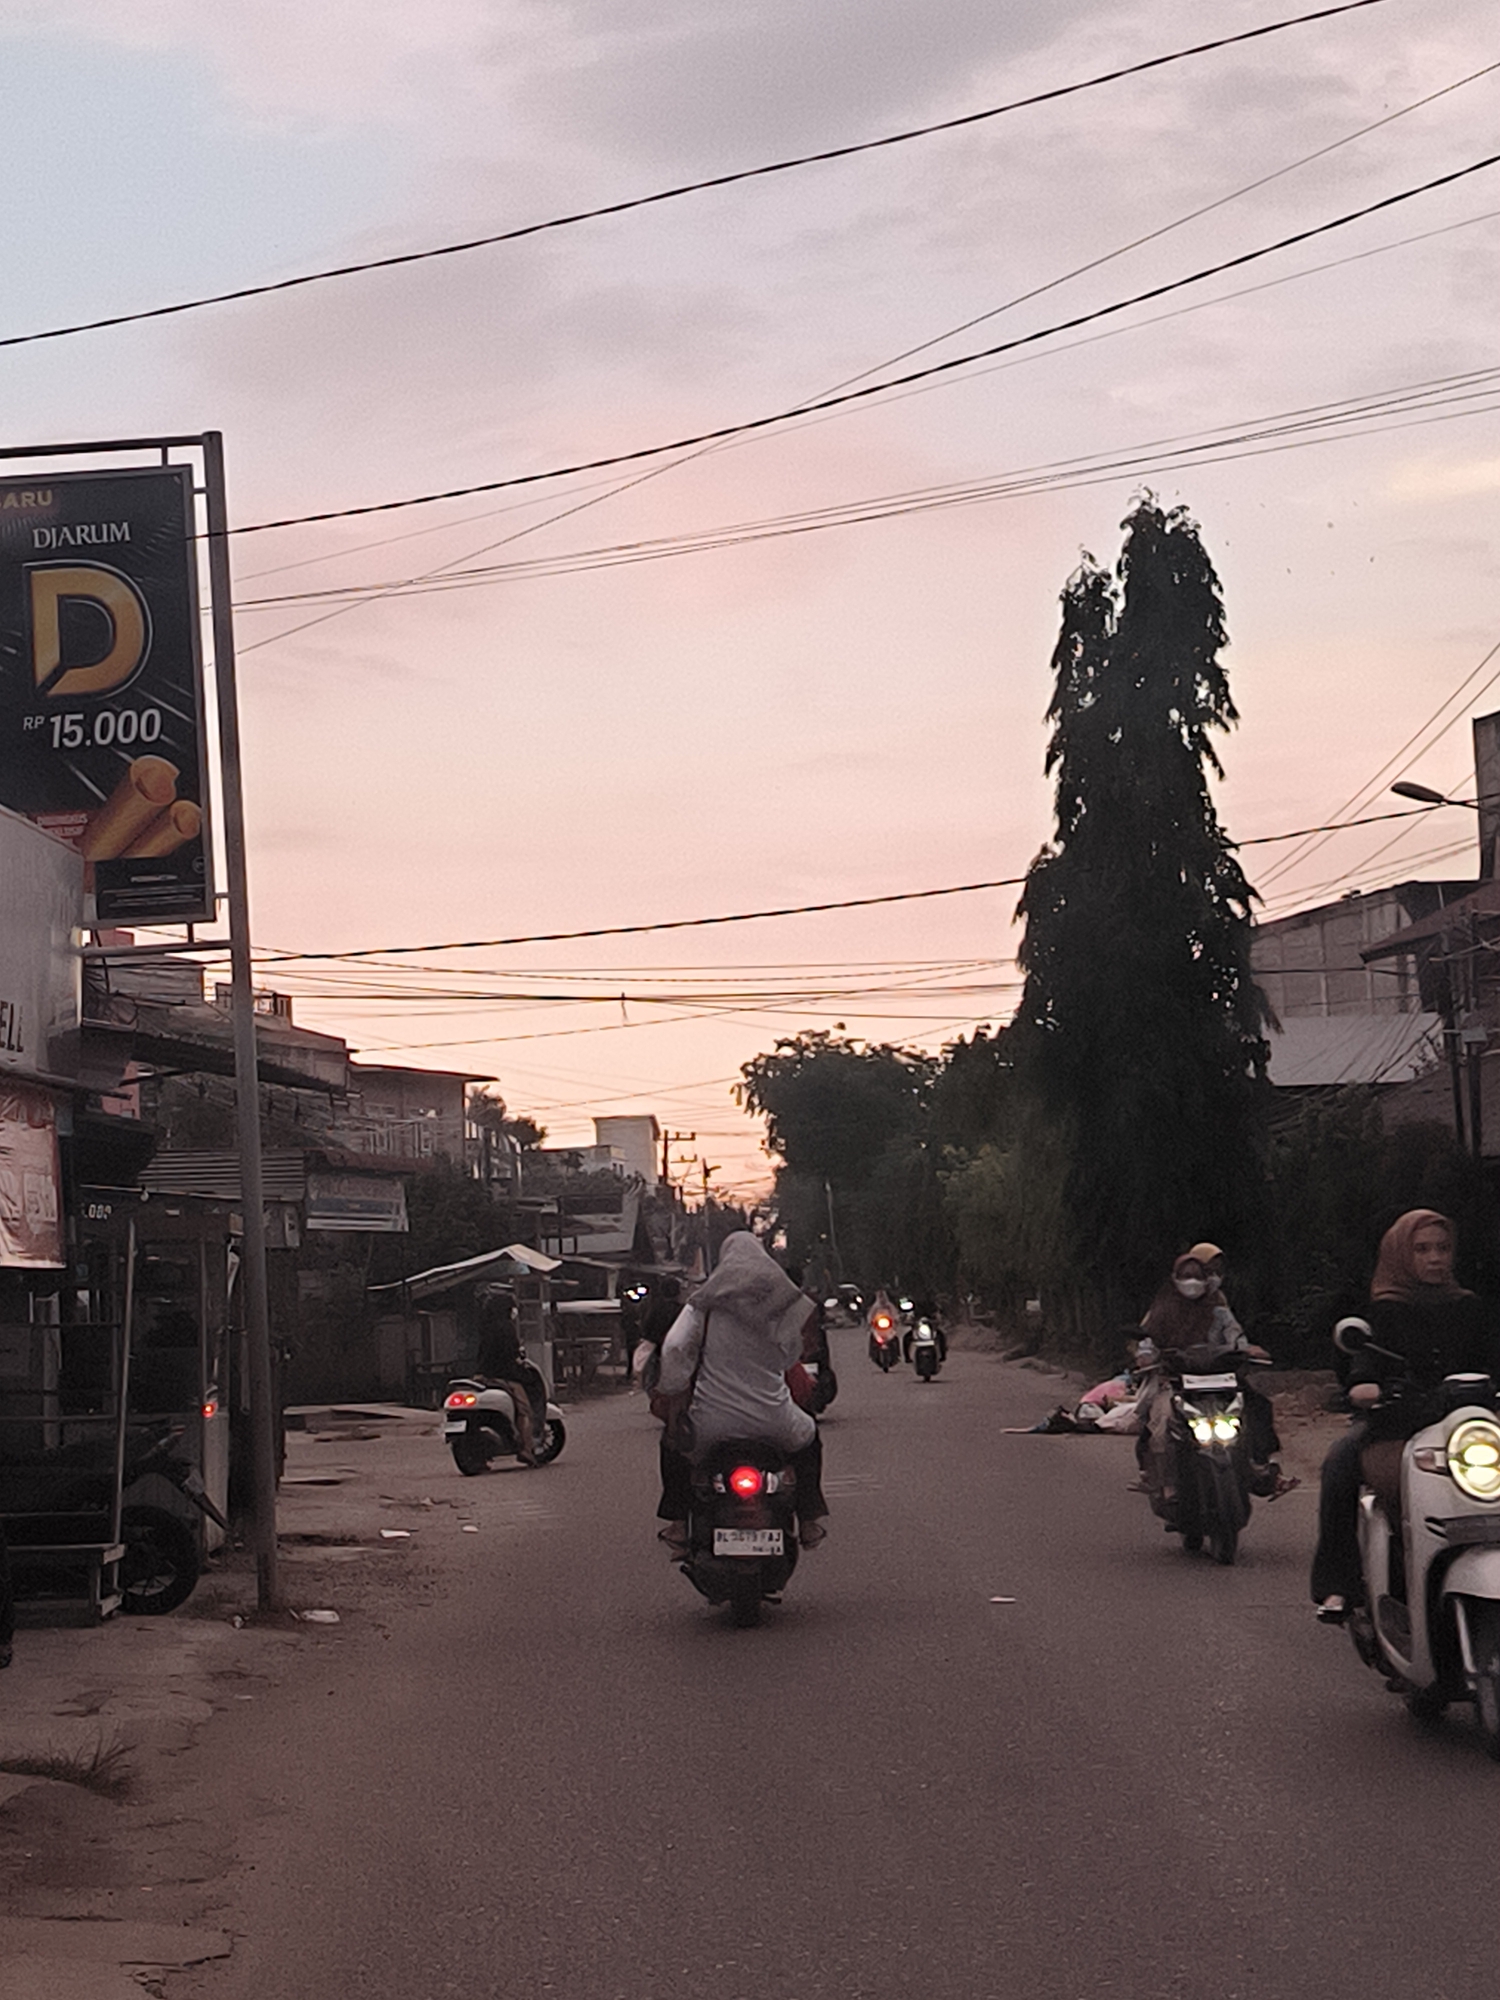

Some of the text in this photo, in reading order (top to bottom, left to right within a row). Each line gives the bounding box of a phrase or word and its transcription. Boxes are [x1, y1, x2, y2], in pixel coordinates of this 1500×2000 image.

[0, 490, 53, 509] ARU
[32, 521, 131, 549] DJARUM
[26, 561, 151, 699] D
[23, 708, 161, 748] RP 15.000
